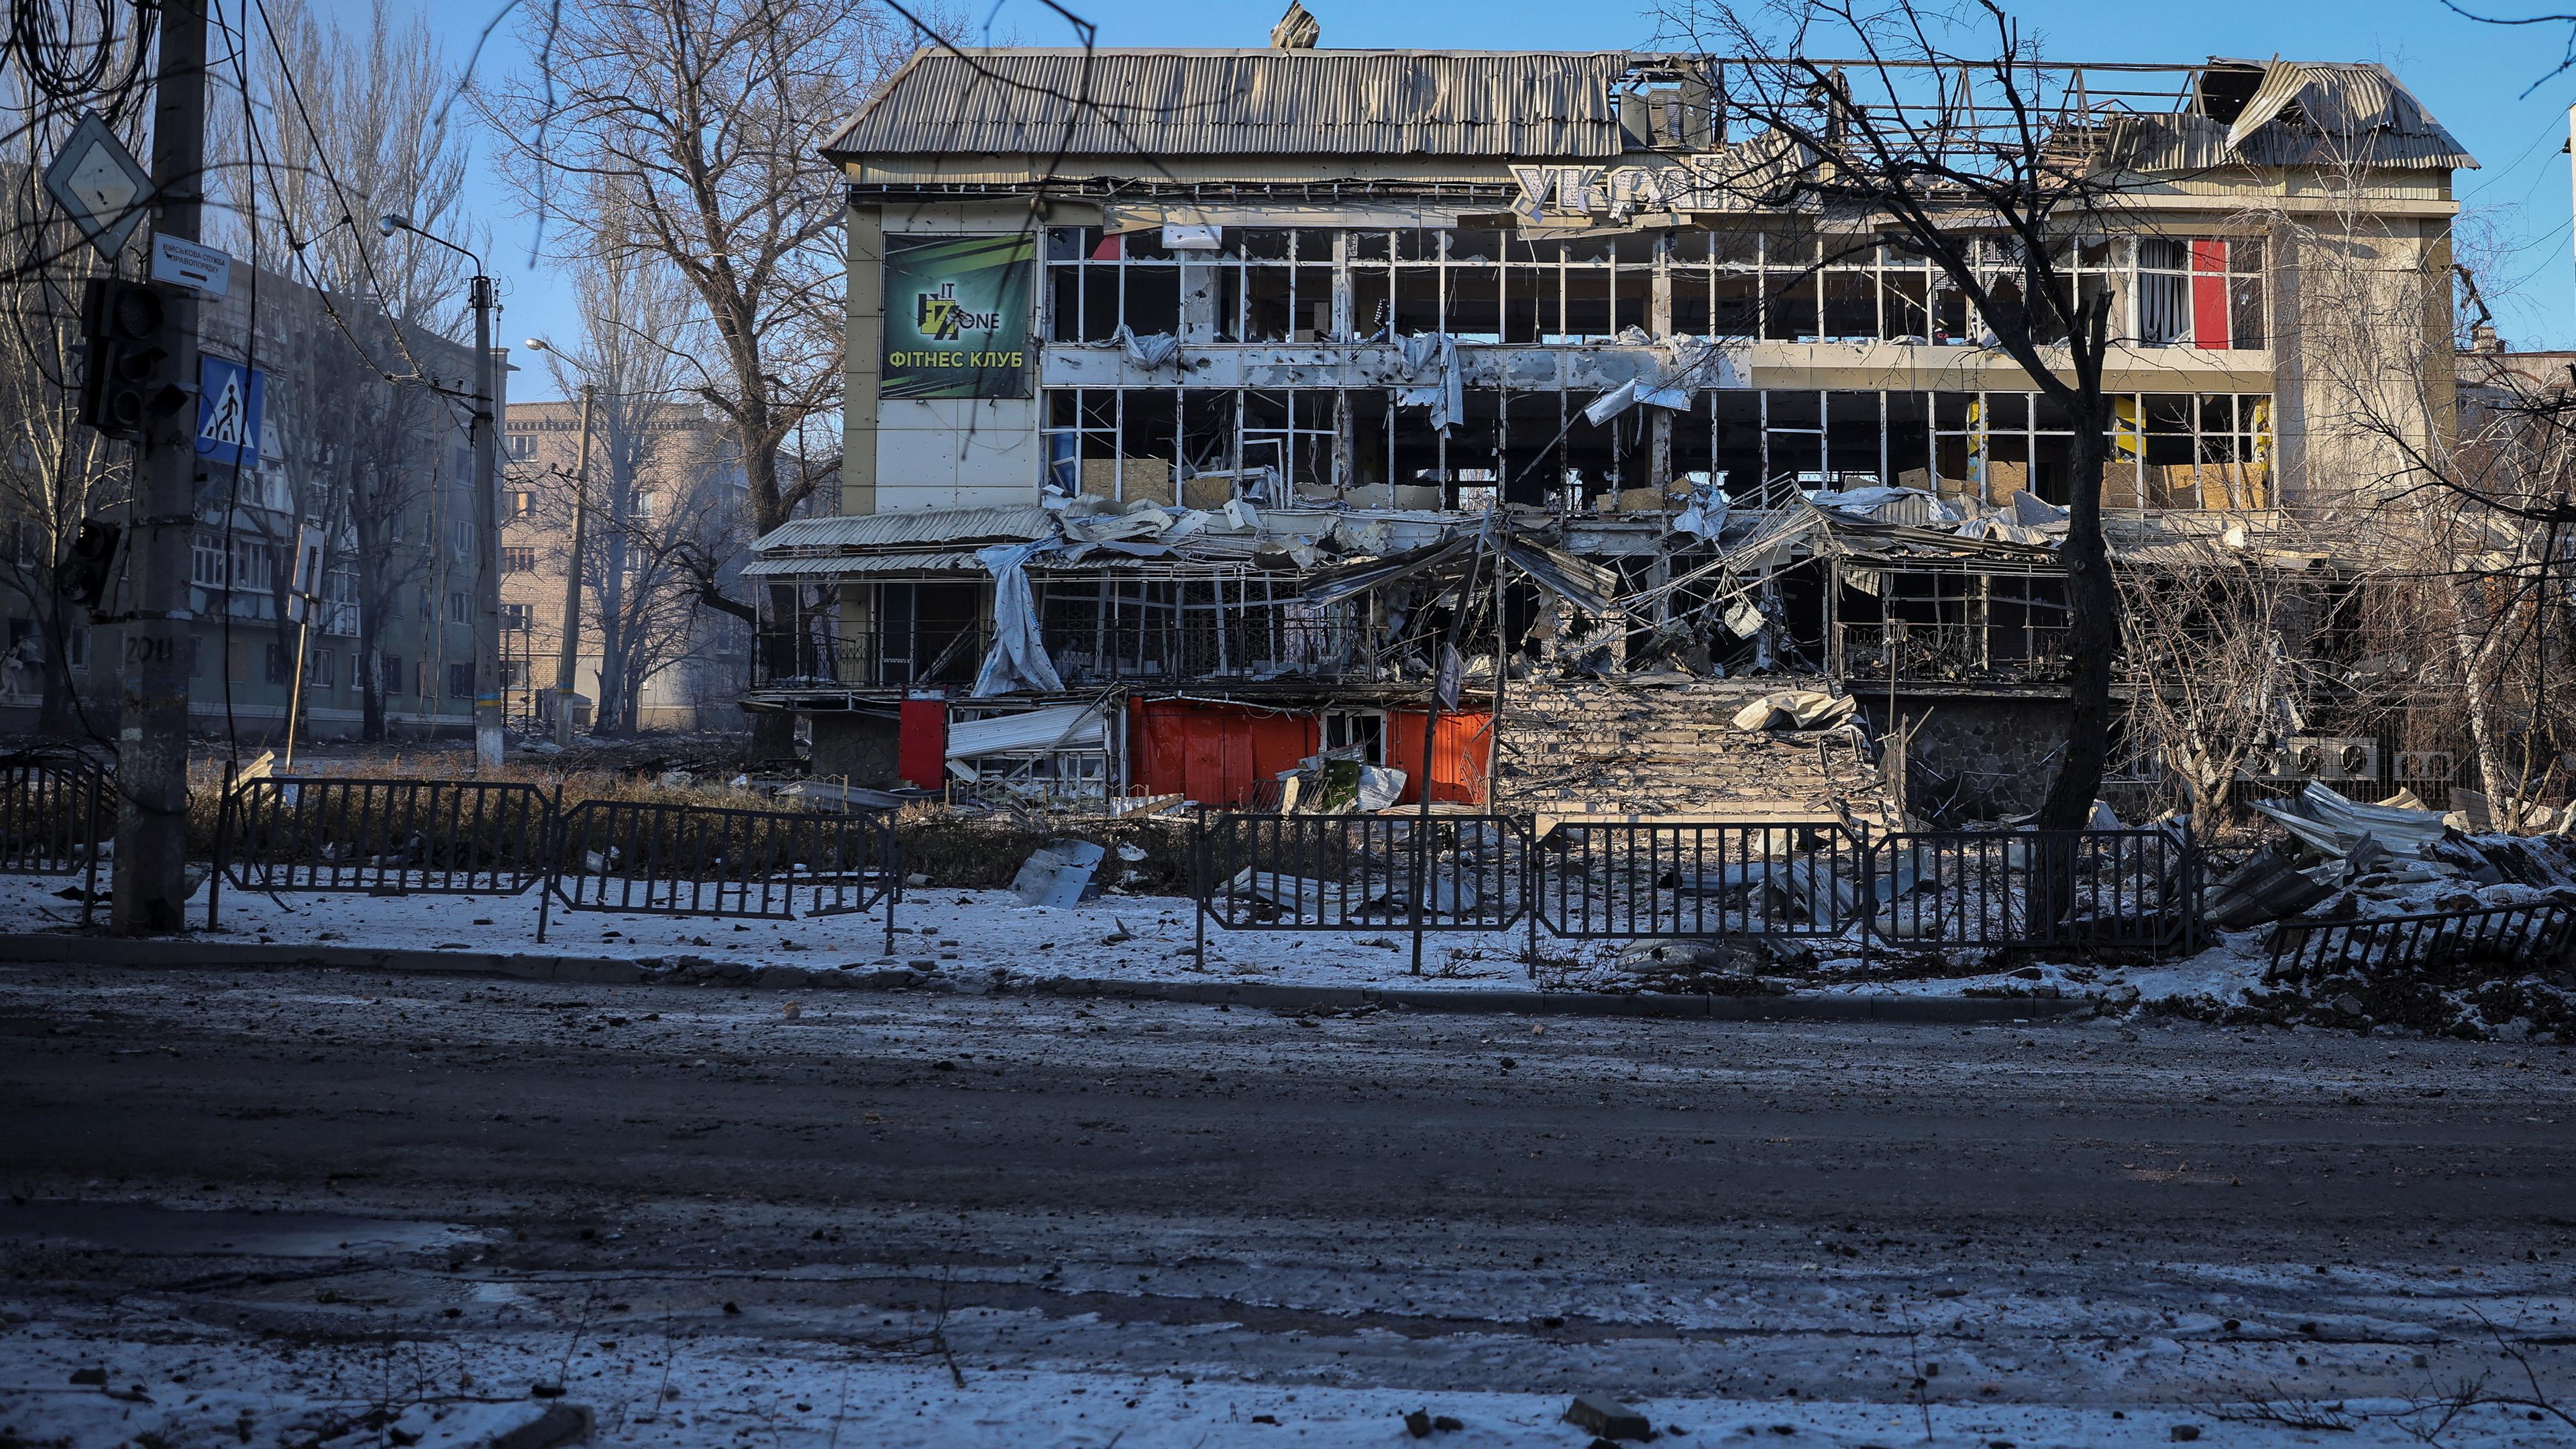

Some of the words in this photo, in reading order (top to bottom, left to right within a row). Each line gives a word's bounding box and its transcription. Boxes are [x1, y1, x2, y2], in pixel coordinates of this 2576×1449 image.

[1507, 154, 1824, 225] УКРАЇ
[163, 244, 201, 258] ВІЙСЬКОВА
[203, 254, 225, 267] СЛУЖБА
[170, 254, 219, 274] ПРАВОПОРЯДКУ
[889, 351, 963, 368] ФІТНЕС
[970, 352, 1022, 368] КЛУБ
